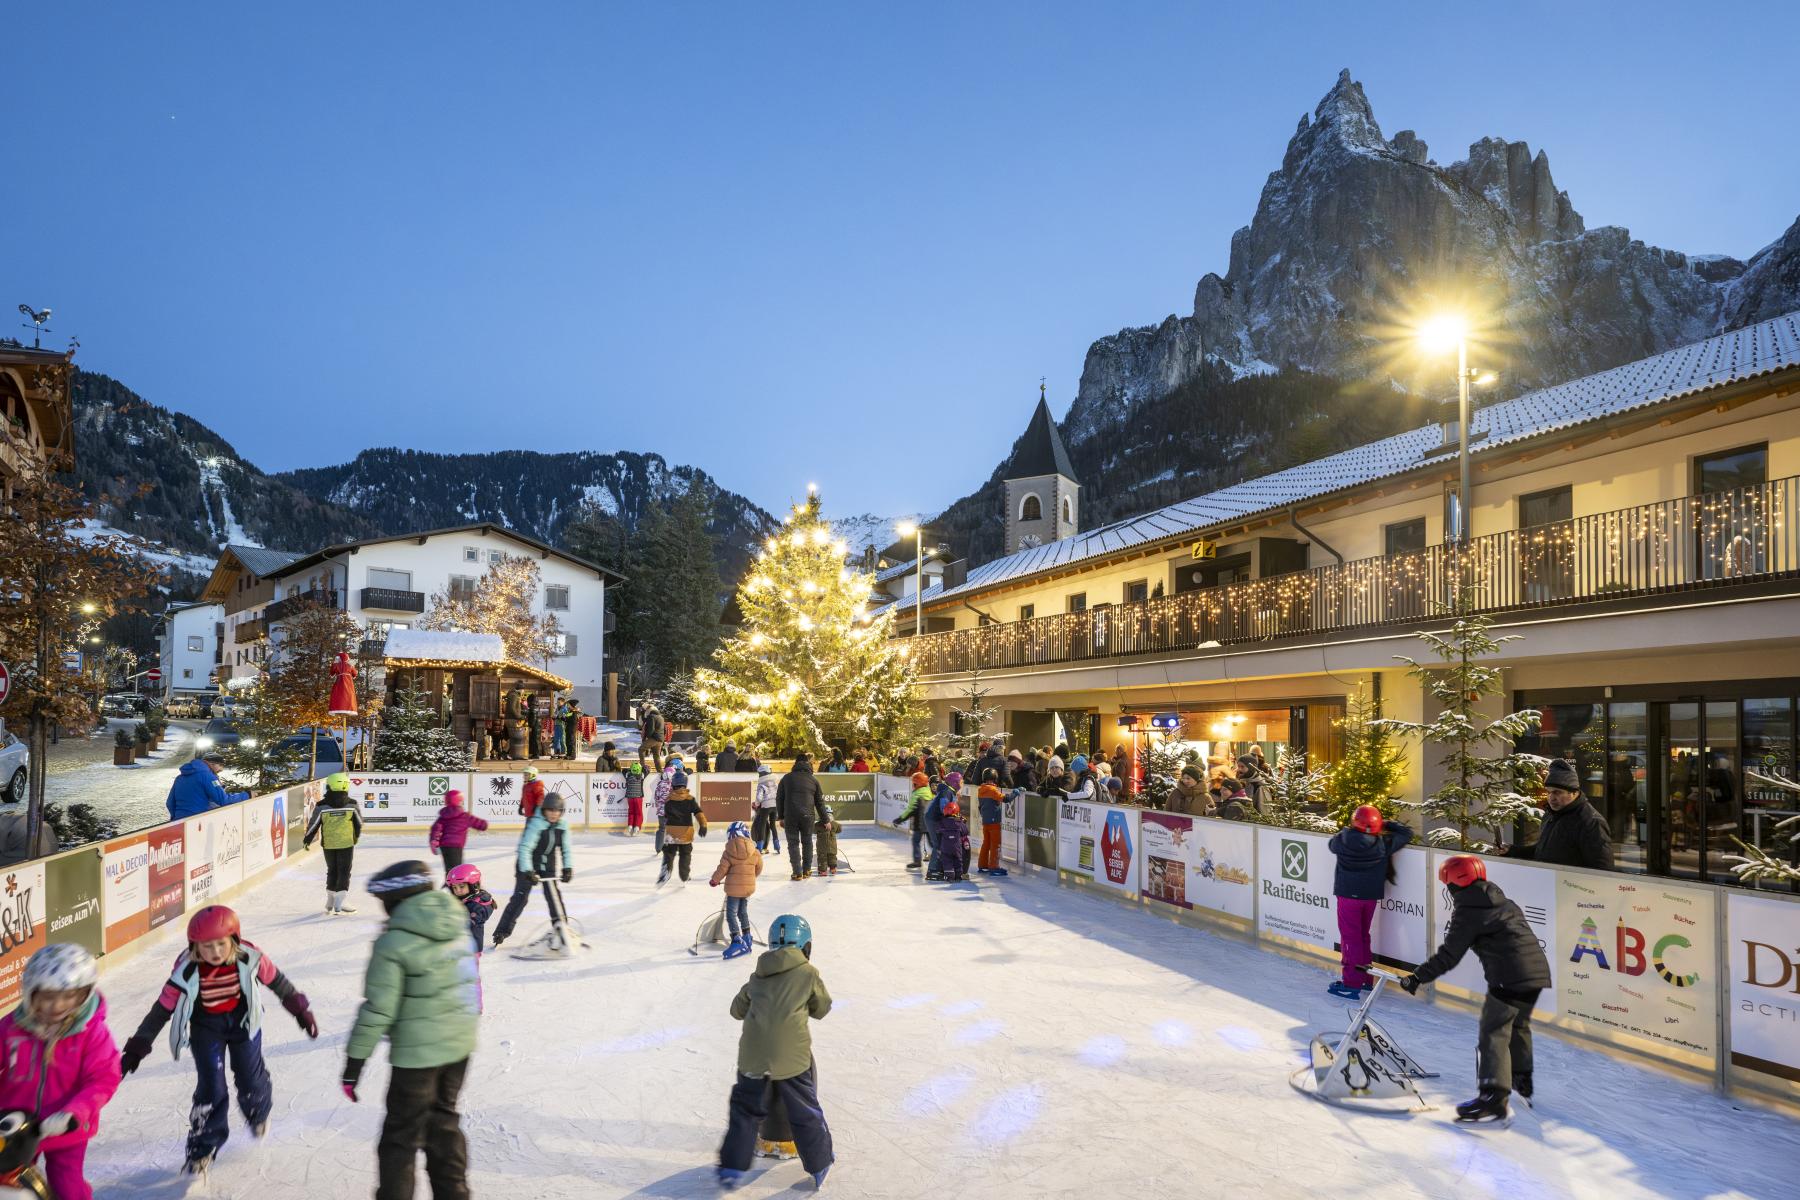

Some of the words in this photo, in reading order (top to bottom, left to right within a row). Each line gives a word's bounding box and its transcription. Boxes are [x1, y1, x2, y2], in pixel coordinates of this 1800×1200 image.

[592, 782, 627, 790] NICOLU
[1747, 791, 1786, 801] SERVICE
[412, 797, 445, 807] Raiffe
[478, 797, 521, 806] Schwarze
[105, 863, 119, 878] MAL
[125, 853, 148, 872] DECOR
[192, 875, 213, 896] MARKET
[1263, 878, 1330, 909] Raiffeisen
[1377, 898, 1424, 918] LORIAN
[0, 975, 18, 990] utdoor
[1320, 1044, 1335, 1065] RO
[1374, 1034, 1407, 1067] ROXA
[1365, 1057, 1406, 1090] ROXA
